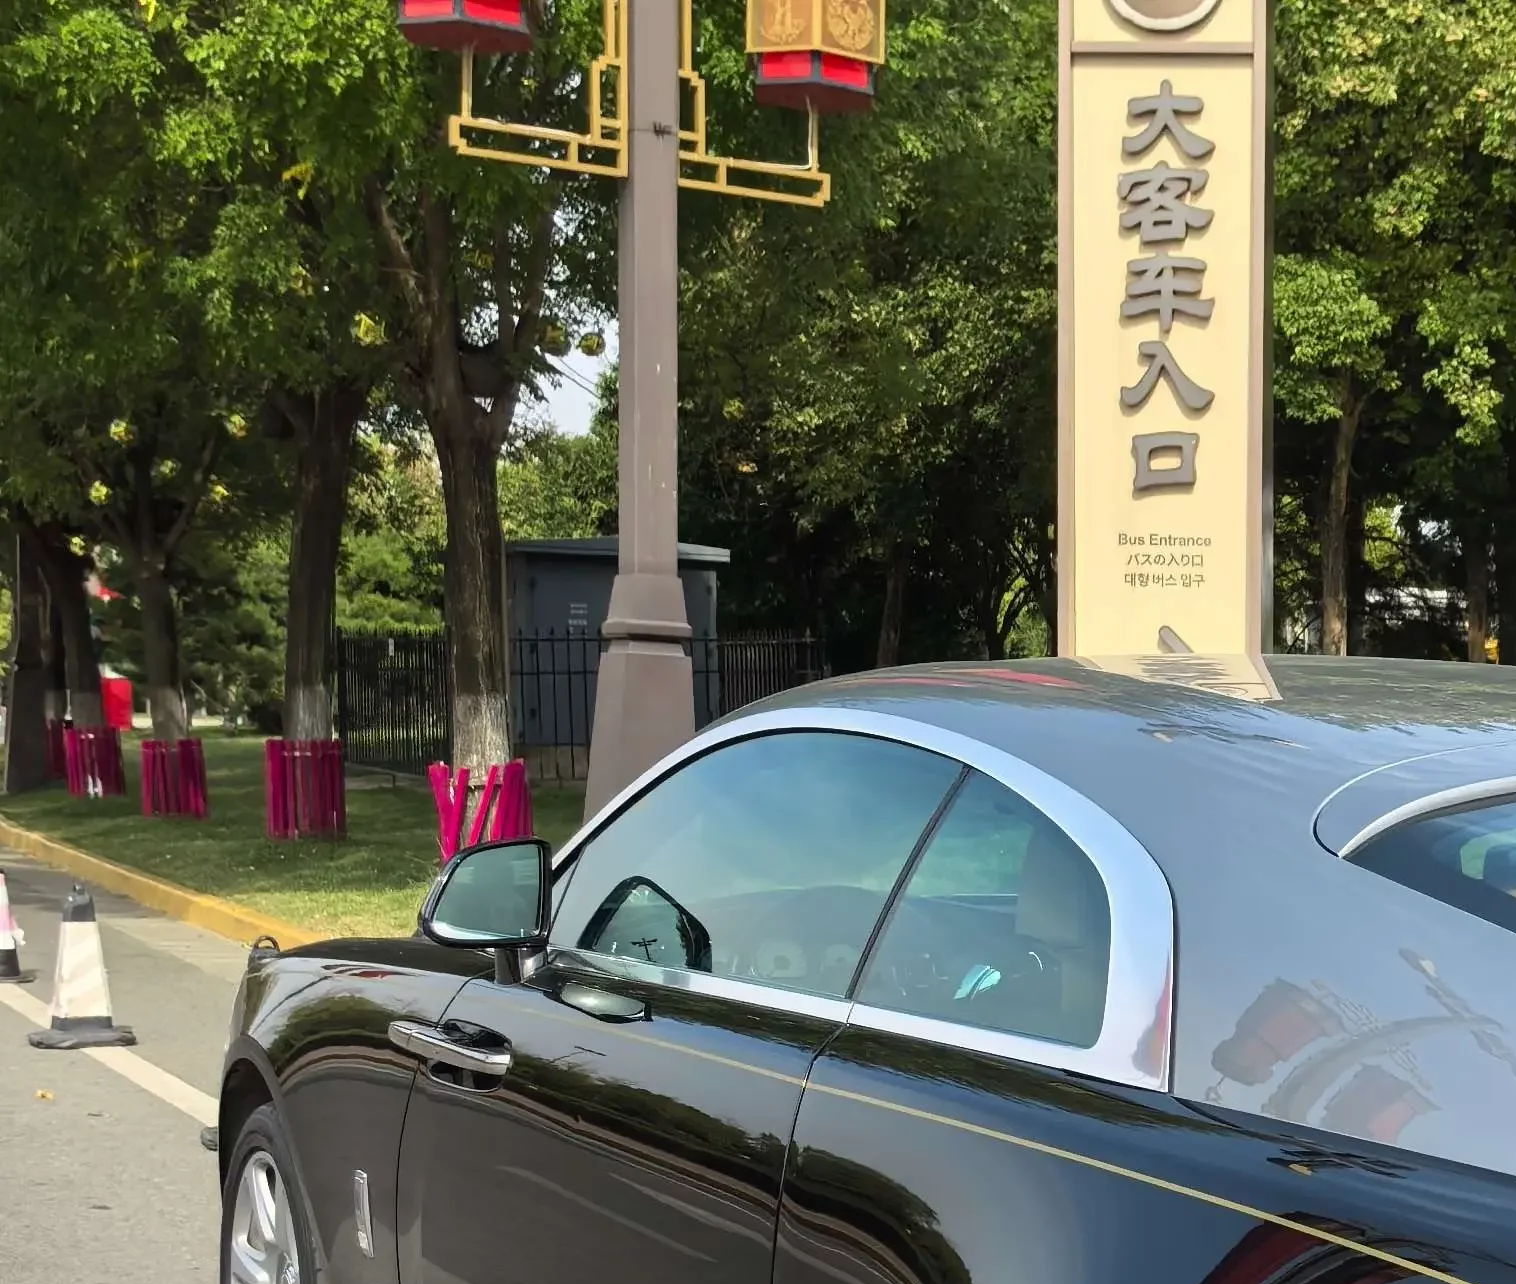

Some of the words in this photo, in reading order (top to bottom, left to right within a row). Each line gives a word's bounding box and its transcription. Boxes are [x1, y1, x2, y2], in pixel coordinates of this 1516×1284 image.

[1117, 79, 1216, 497] 大客车入口
[1118, 533, 1145, 546] Bus
[1149, 533, 1212, 547] Entrance
[1127, 553, 1204, 567] バスの入り口
[1124, 573, 1149, 587] 대형
[1152, 573, 1178, 588] 버스
[1180, 574, 1205, 588] 입구
